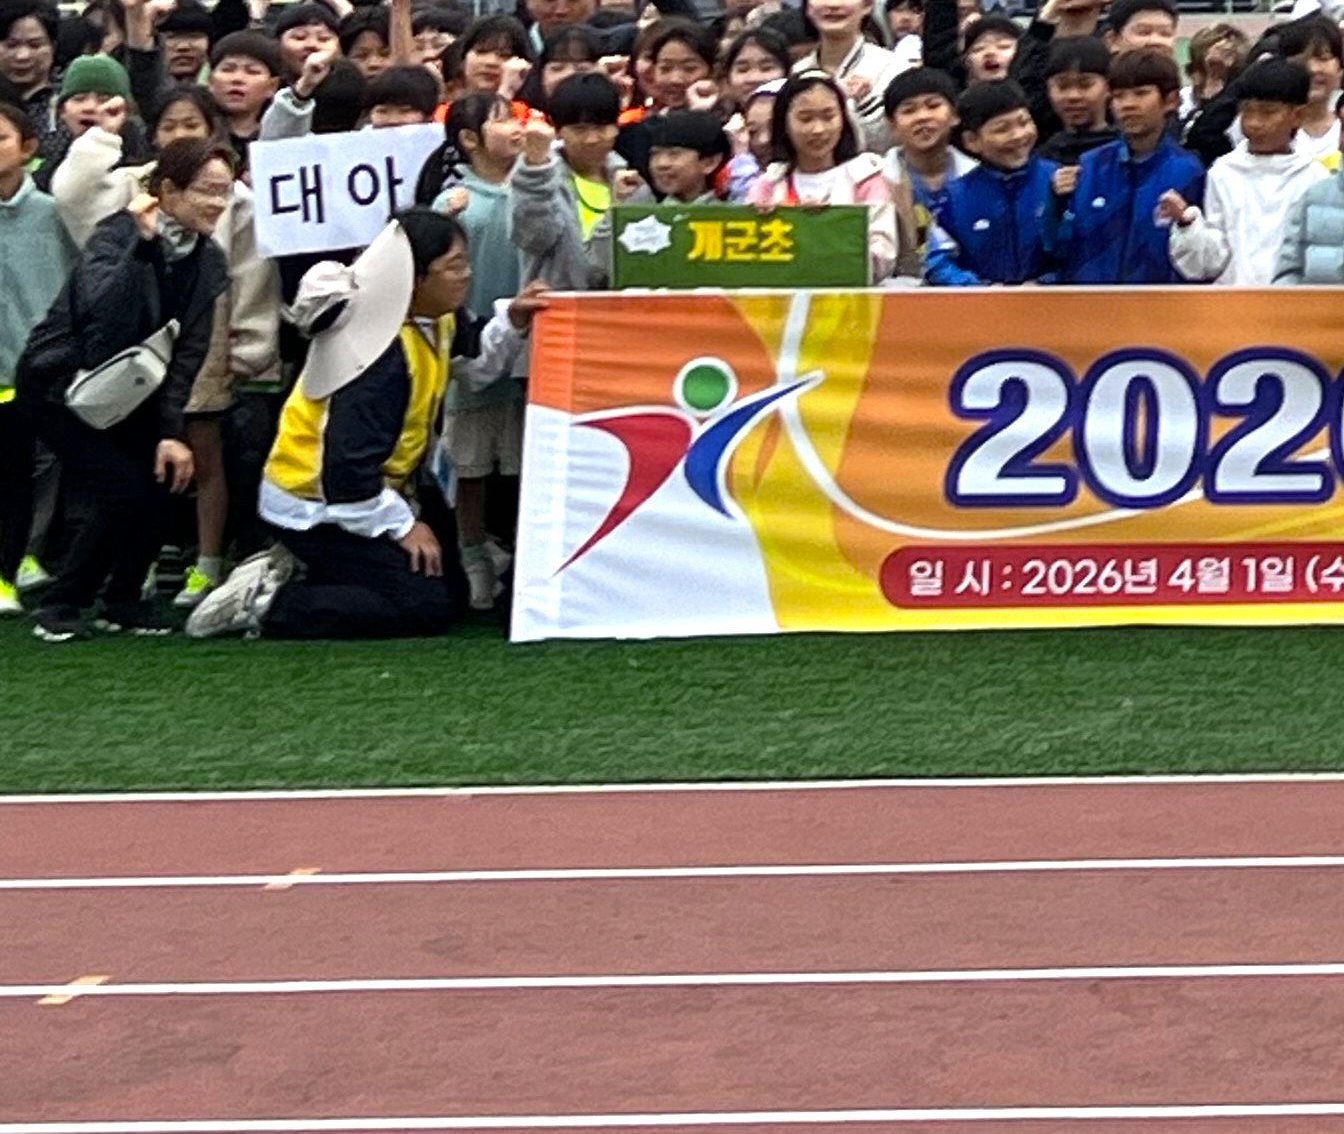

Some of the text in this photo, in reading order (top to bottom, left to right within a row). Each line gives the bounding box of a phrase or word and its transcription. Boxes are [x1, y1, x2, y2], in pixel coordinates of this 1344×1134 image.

[687, 219, 794, 263] 개군초
[909, 559, 944, 596] 일
[1021, 557, 1157, 595] 2026년
[1168, 558, 1231, 594] 4월
[1242, 557, 1293, 593] 1일
